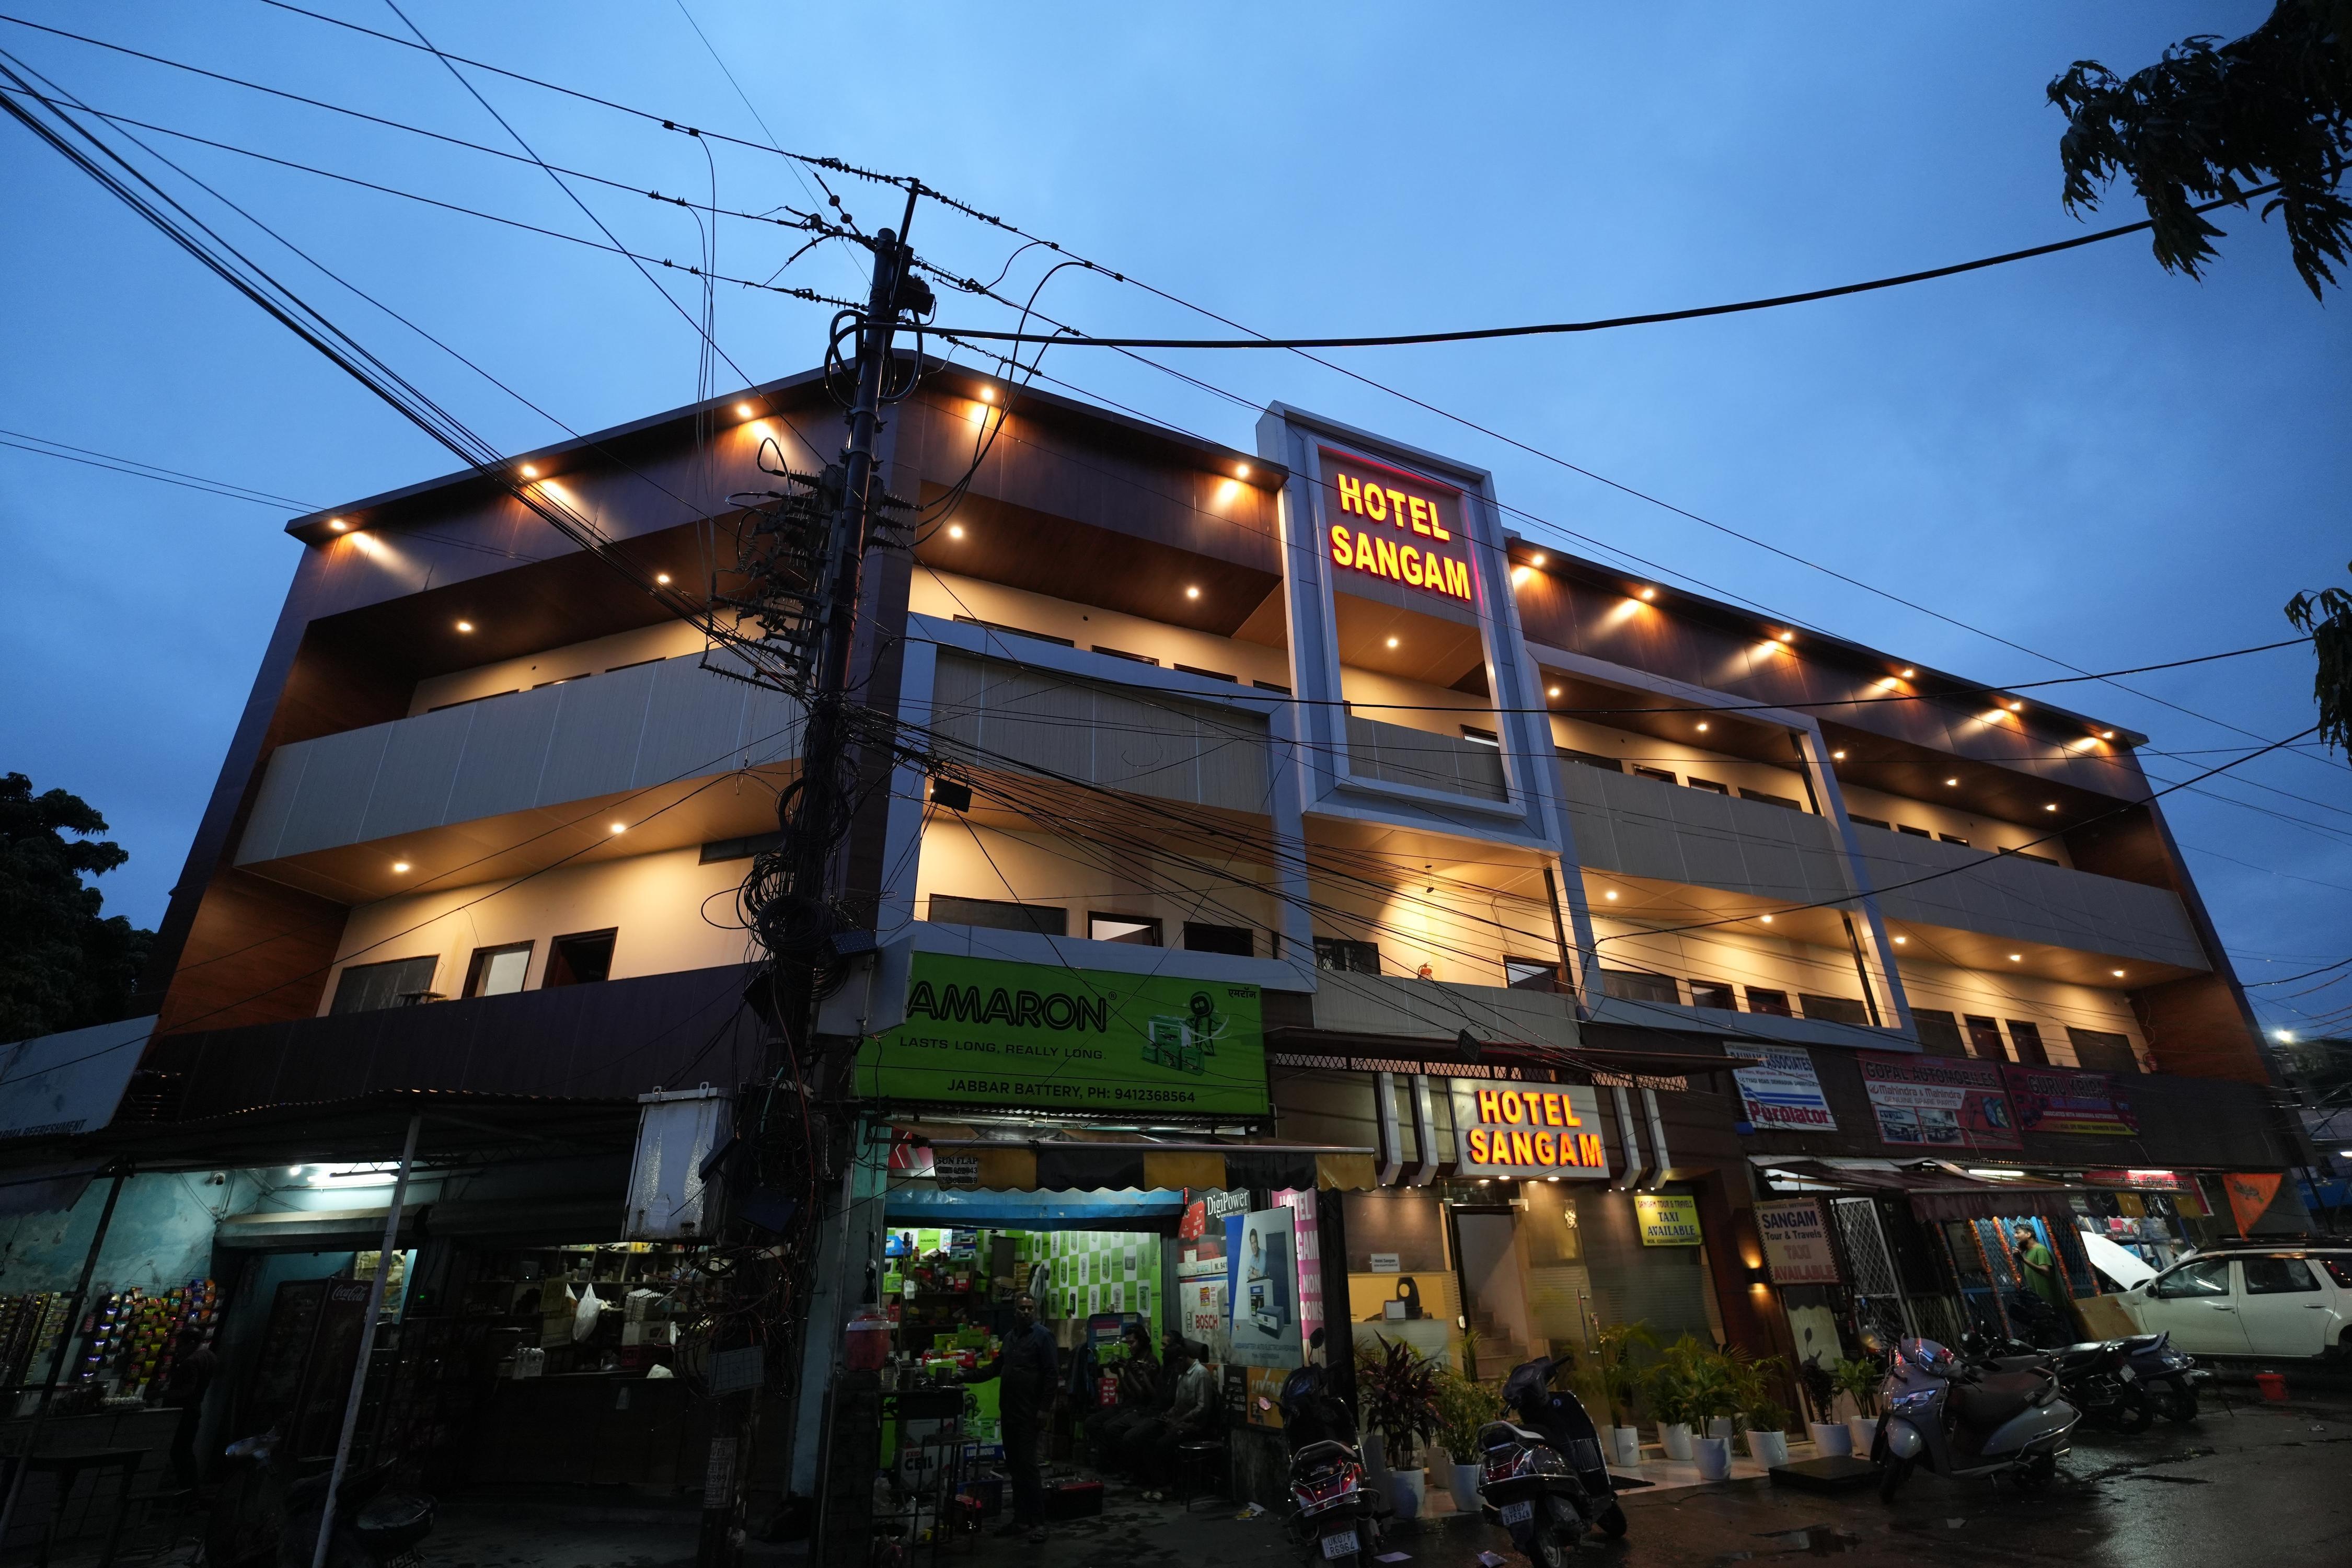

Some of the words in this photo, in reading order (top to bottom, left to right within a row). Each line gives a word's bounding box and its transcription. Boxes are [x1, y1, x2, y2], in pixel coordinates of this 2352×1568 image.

[1338, 473, 1450, 541] HOTEL
[1330, 525, 1471, 601] SANGAM
[1227, 987, 1256, 999] एमरॉन
[906, 981, 1107, 1033] AMARON
[900, 1036, 948, 1048] LASTS
[955, 1041, 1000, 1054] LONG,
[1005, 1044, 1058, 1057] REALLY
[1064, 1047, 1106, 1060] LONG.
[1765, 1054, 1813, 1071] ASSOCIATES
[1865, 1062, 1908, 1081] GOPAL
[1912, 1065, 1997, 1088] AUTOMOBILES
[947, 1079, 1009, 1094] JABBAR
[1014, 1082, 1083, 1099] BATTERY,
[1088, 1087, 1110, 1099] PH:
[1114, 1088, 1195, 1103] 9412368564
[1878, 1085, 1918, 1096] Mahindra
[1925, 1088, 1962, 1099] Mahindra
[2027, 1074, 2067, 1097] GURU
[2066, 1077, 2109, 1100] KRIPA
[1475, 1089, 1582, 1127] HOTEL
[1747, 1100, 1829, 1124] Purolator
[1936, 1098, 1958, 1106] PARTS
[1467, 1128, 1605, 1167] SANGAM
[1206, 1191, 1248, 1219] DigiPower
[1657, 1212, 1679, 1223] TAXI
[1761, 1210, 1818, 1229] SANGAM
[1647, 1225, 1696, 1236] AVAILABLE
[1764, 1231, 1782, 1241] Tour
[1784, 1230, 1791, 1240] &
[1792, 1229, 1822, 1239] Travels
[1296, 1230, 1320, 1261] GAM
[1783, 1244, 1812, 1260] TAXI
[1774, 1264, 1836, 1280] AVAILABLE
[1302, 1274, 1322, 1294] NON
[1300, 1300, 1324, 1321] OOMS
[1195, 1315, 1219, 1330] BOSCH
[1507, 1503, 1526, 1514] UK07
[1327, 1531, 1351, 1546] UK07F
